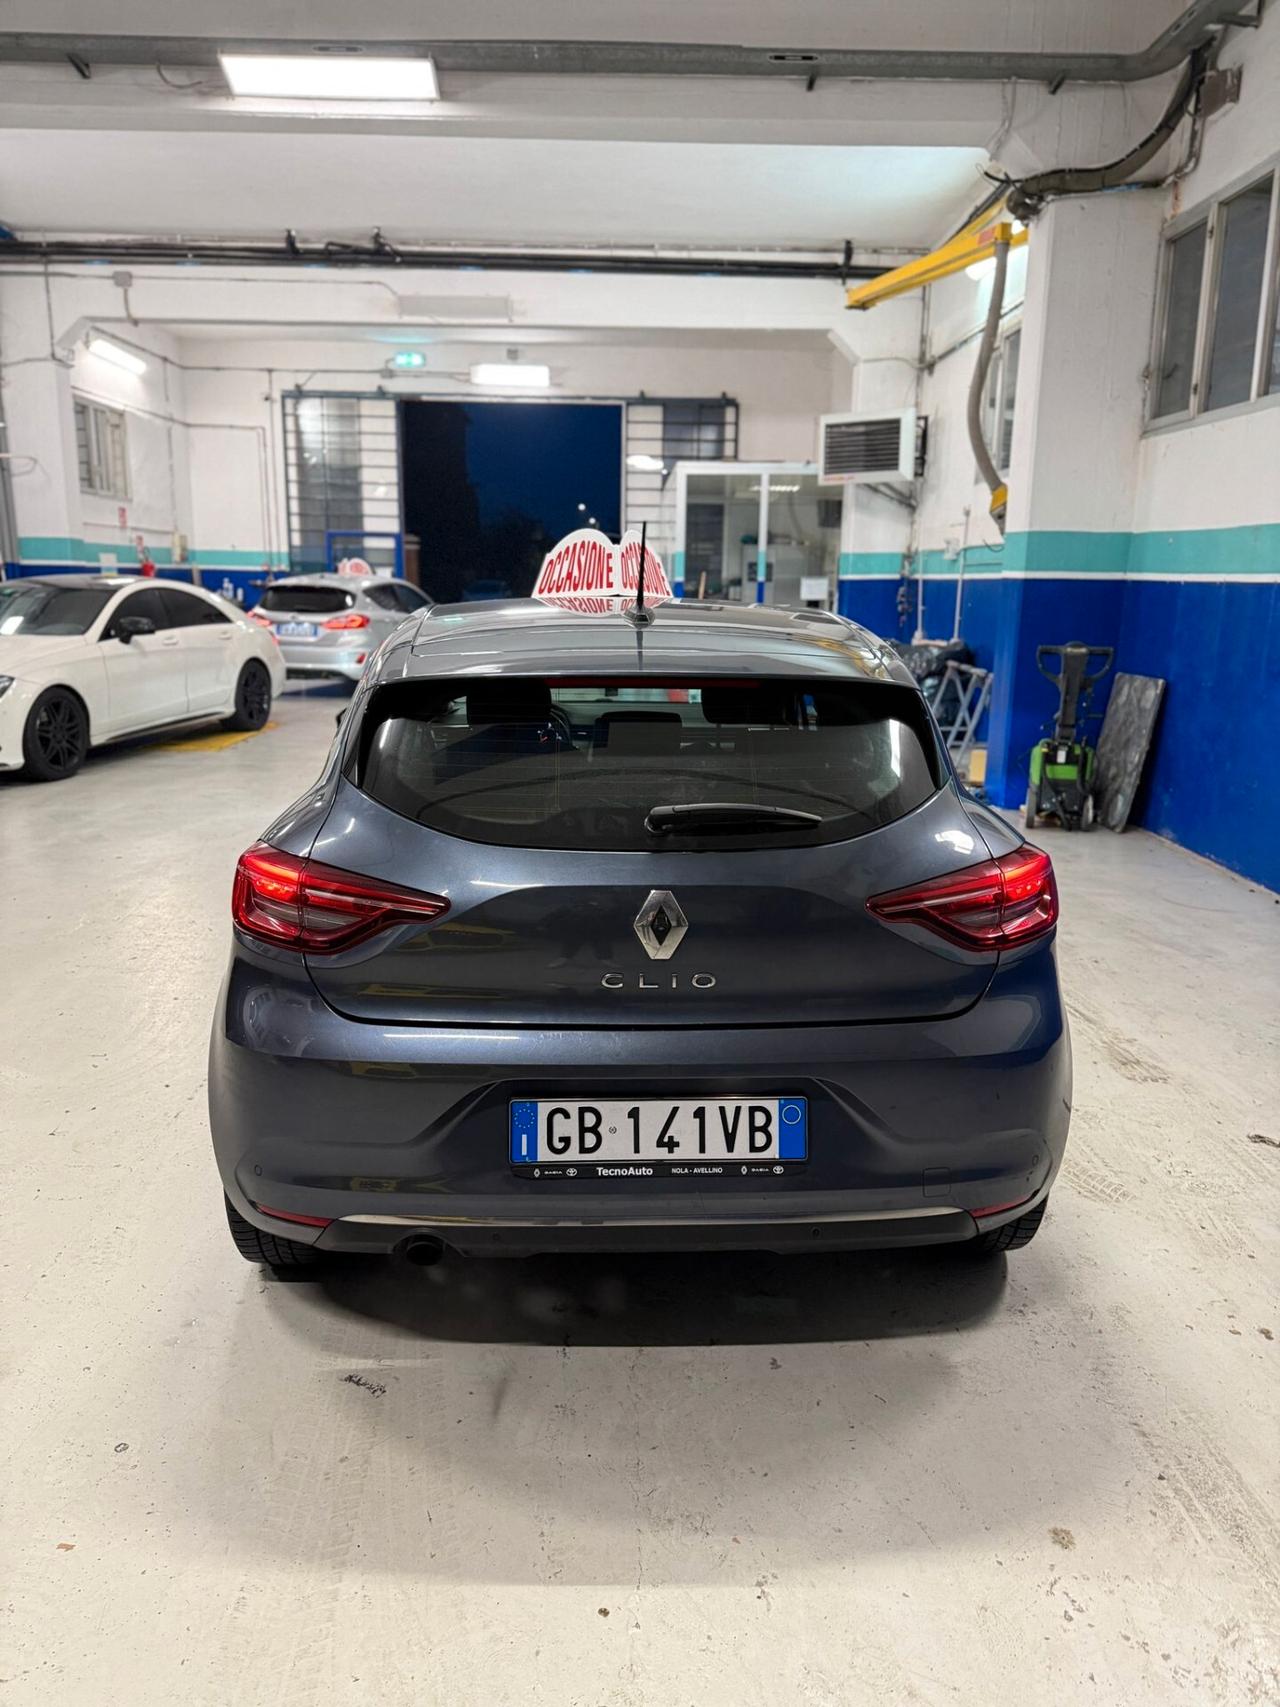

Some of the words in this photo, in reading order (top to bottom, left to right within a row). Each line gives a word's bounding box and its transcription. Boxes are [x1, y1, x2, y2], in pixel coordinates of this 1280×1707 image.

[538, 540, 614, 595] OCCASIONE
[601, 973, 716, 989] CLIO
[546, 1106, 603, 1155] GB
[627, 1105, 773, 1154] 141VB
[596, 1166, 654, 1177] TecnoAuto
